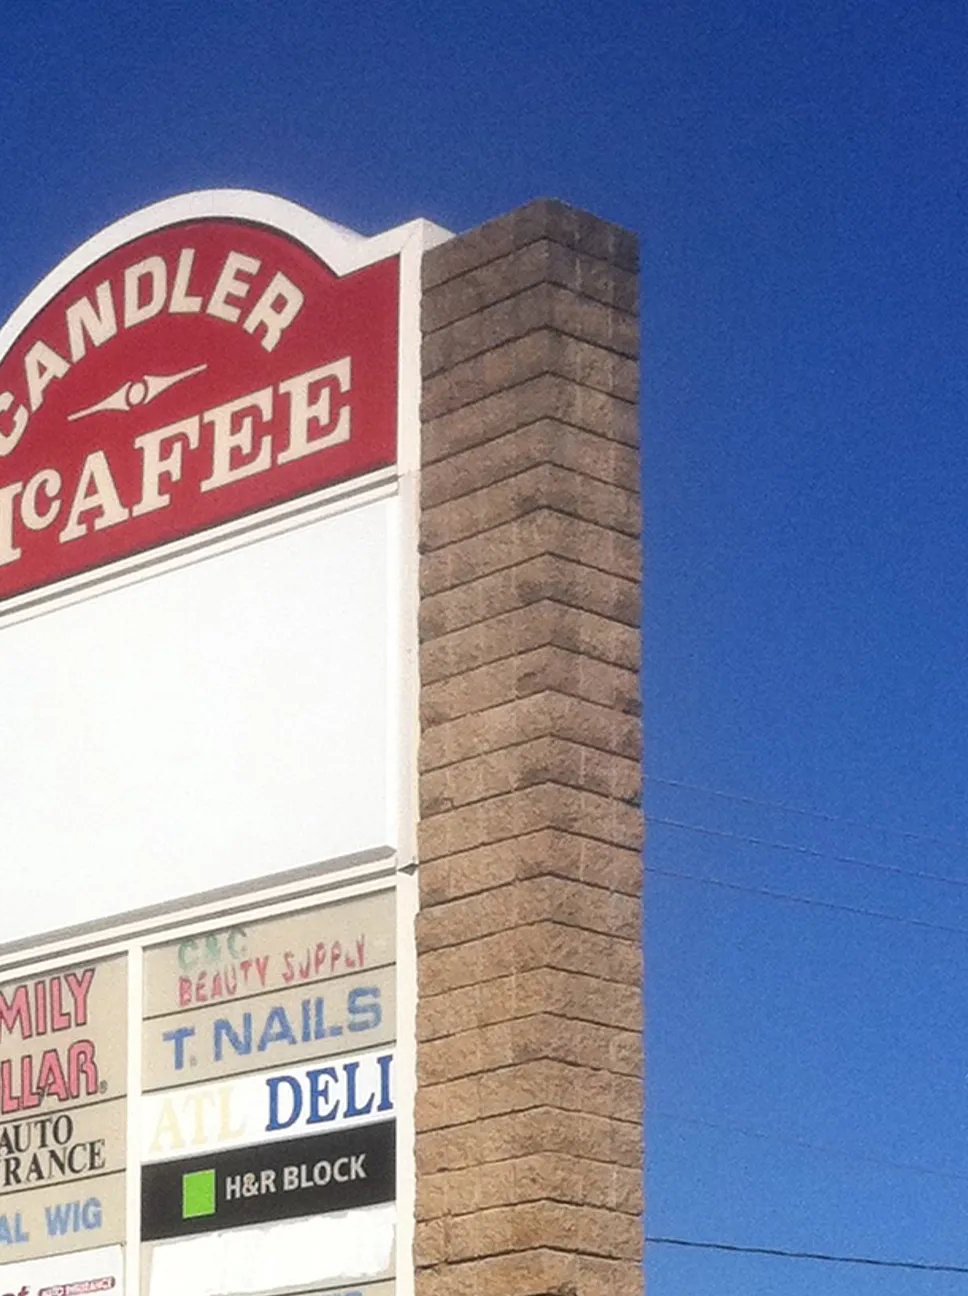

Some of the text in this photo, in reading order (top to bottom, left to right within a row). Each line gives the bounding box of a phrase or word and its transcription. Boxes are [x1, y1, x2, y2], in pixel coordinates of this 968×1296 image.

[179, 934, 366, 1007] BEAUTY SUPPLY
[213, 986, 382, 1061] NAILS
[149, 1055, 394, 1152] ATL DELI
[225, 1154, 368, 1200] H&R BLOCK
[44, 1196, 103, 1237] WIG
